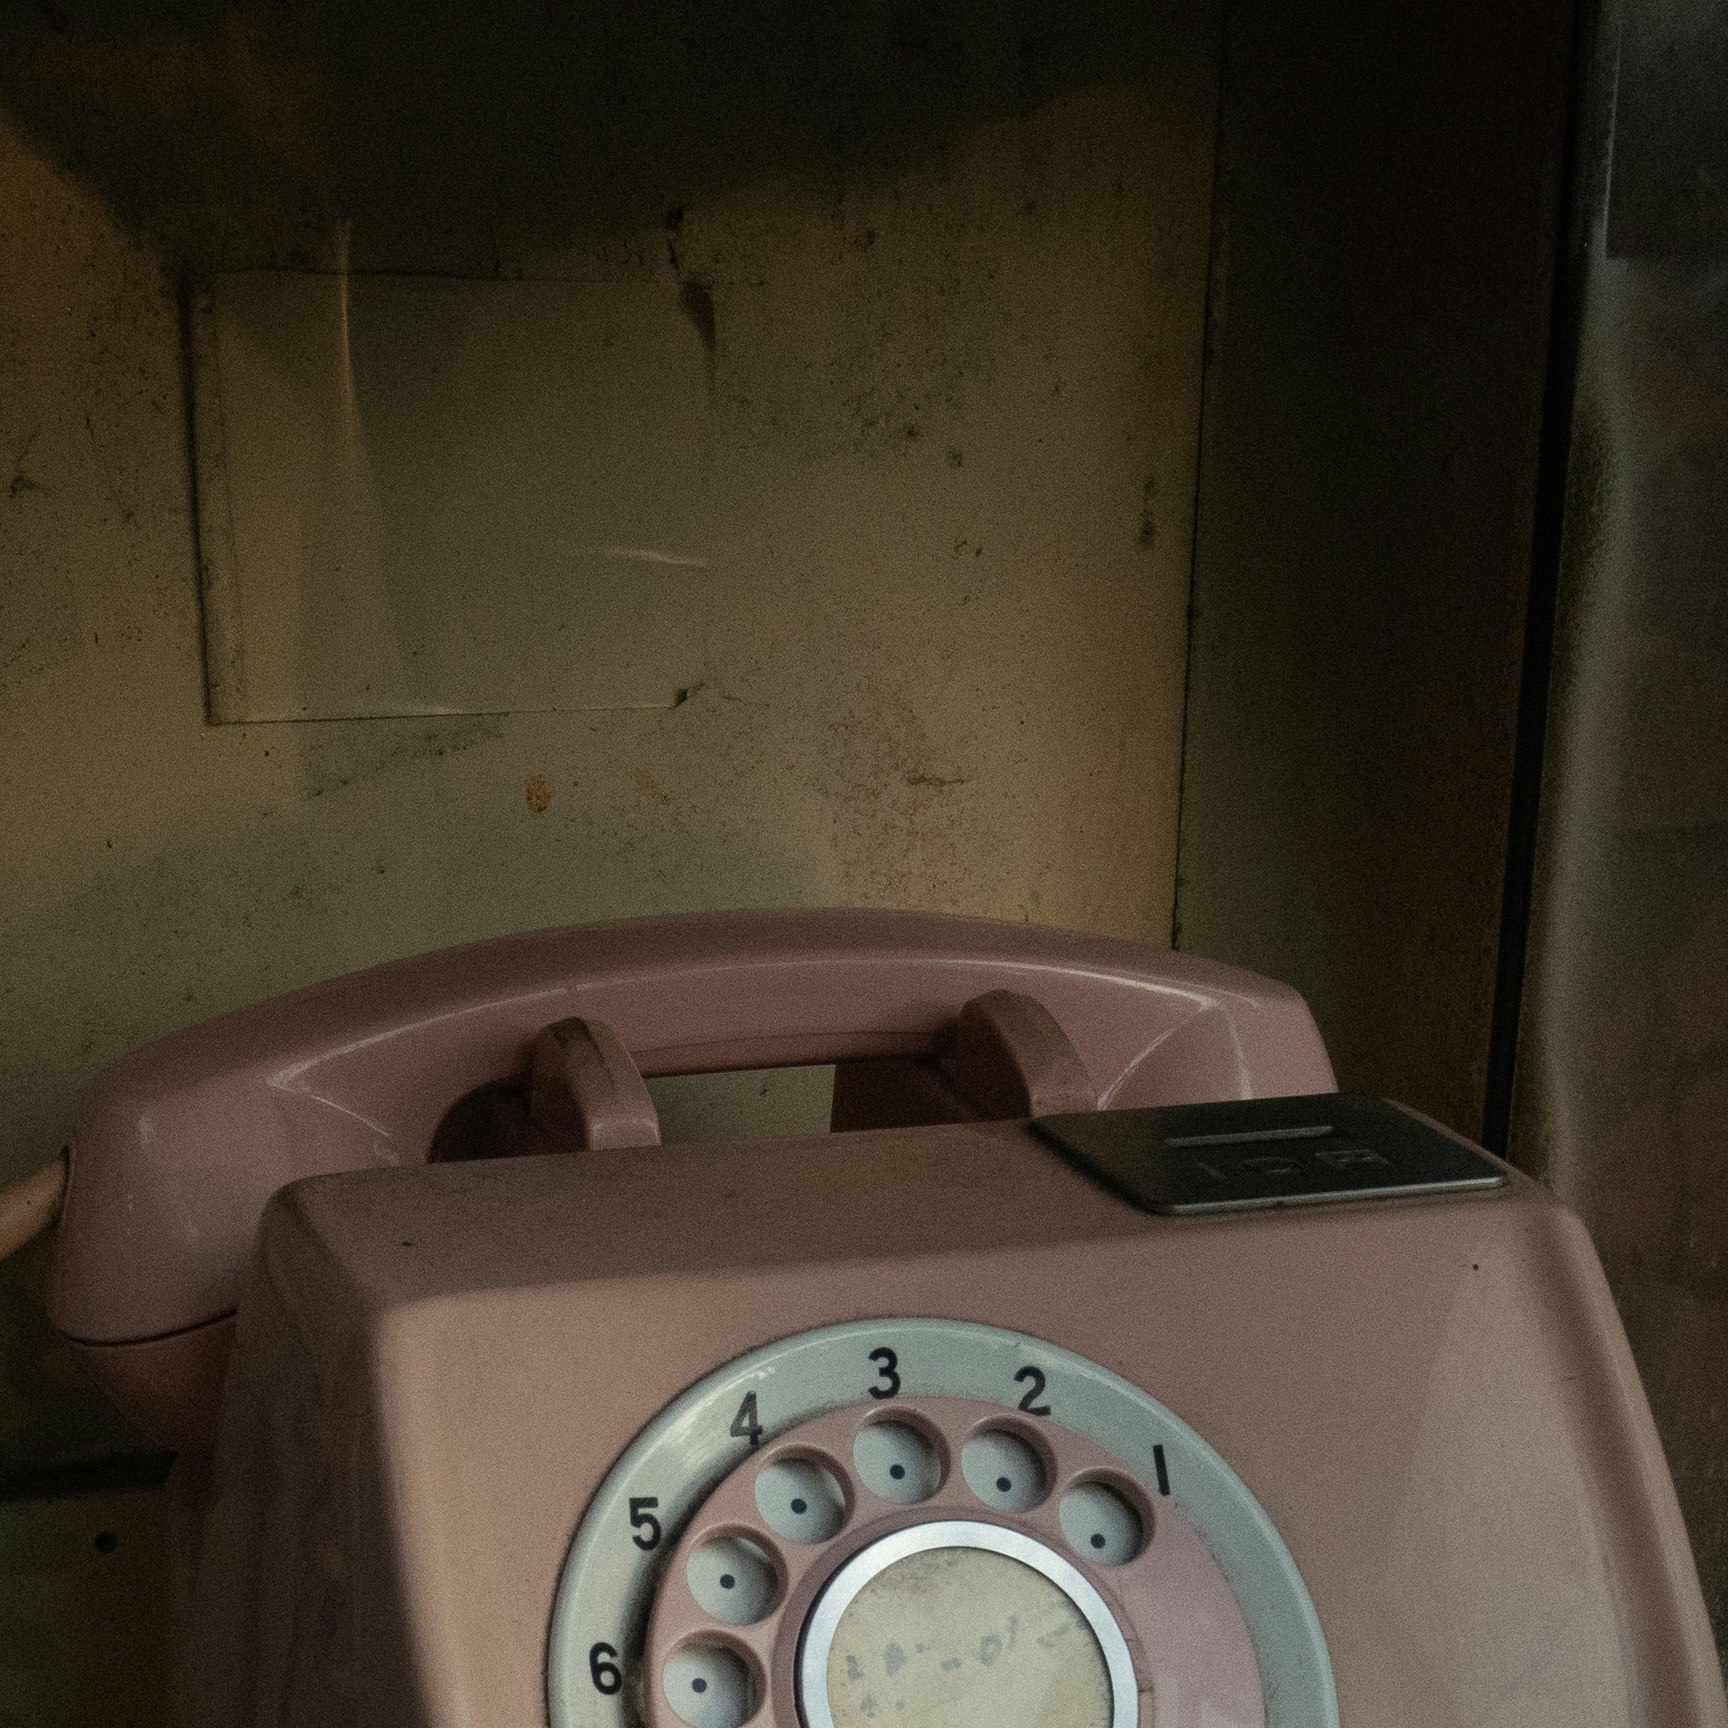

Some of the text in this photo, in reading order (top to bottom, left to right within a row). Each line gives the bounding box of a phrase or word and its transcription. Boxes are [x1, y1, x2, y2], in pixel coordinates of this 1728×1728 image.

[869, 1347, 901, 1400] 3
[1015, 1366, 1051, 1417] 2
[729, 1391, 764, 1447] 4
[1152, 1444, 1171, 1497] 1
[628, 1497, 662, 1552] 5
[589, 1641, 623, 1696] 6
